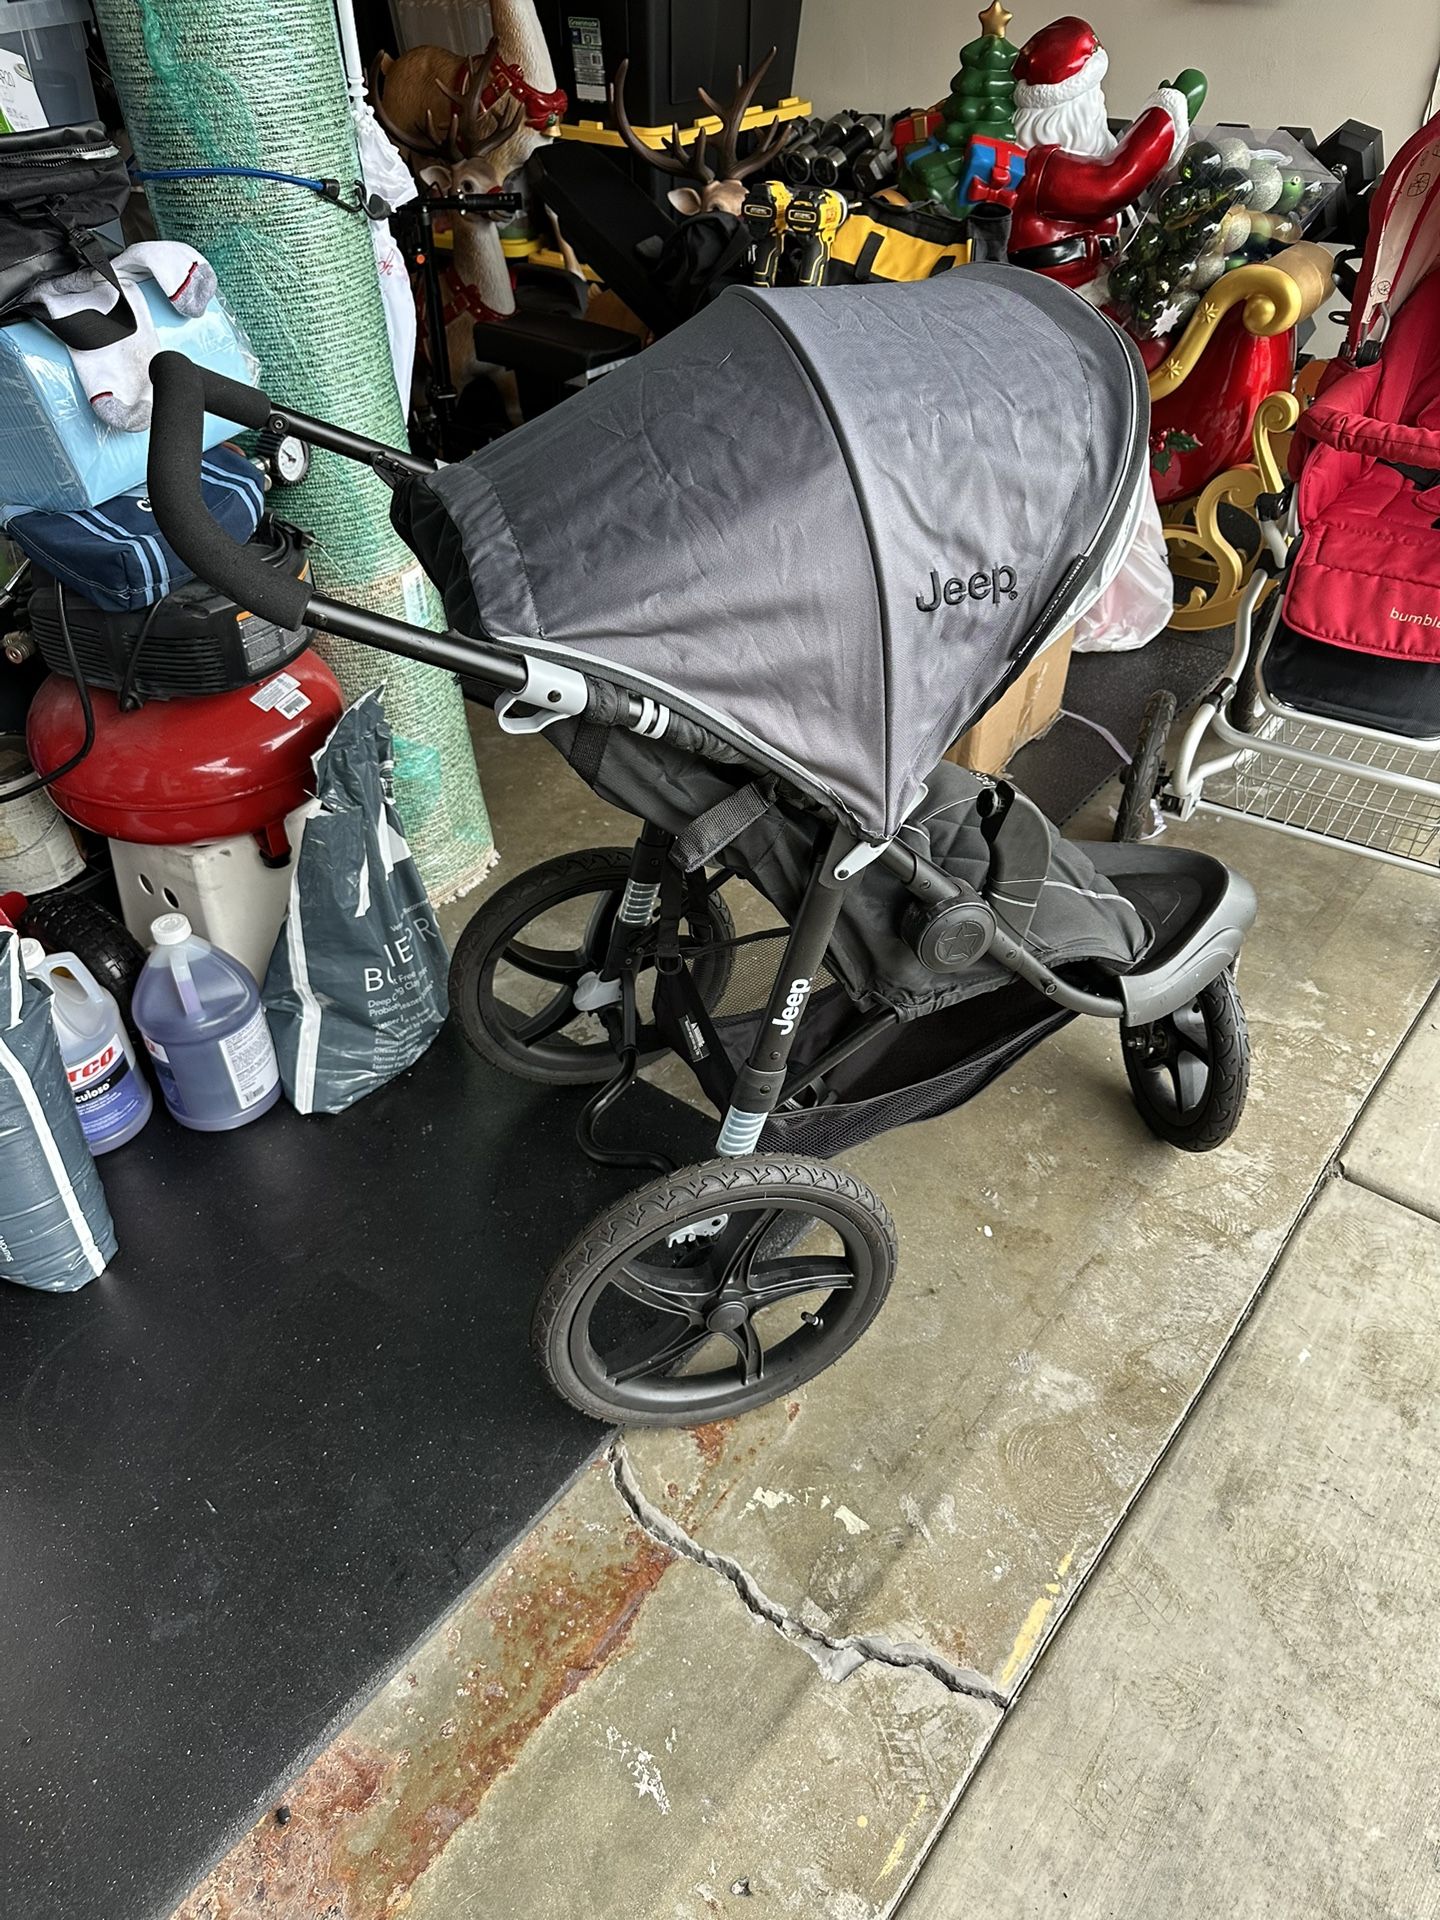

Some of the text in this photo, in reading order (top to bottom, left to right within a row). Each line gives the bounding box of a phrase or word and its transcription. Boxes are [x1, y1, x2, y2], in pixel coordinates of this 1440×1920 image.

[915, 564, 1018, 613] Jeep
[771, 978, 812, 1036] Jeep
[68, 1045, 114, 1084] TCO
[75, 1083, 110, 1104] culoso
